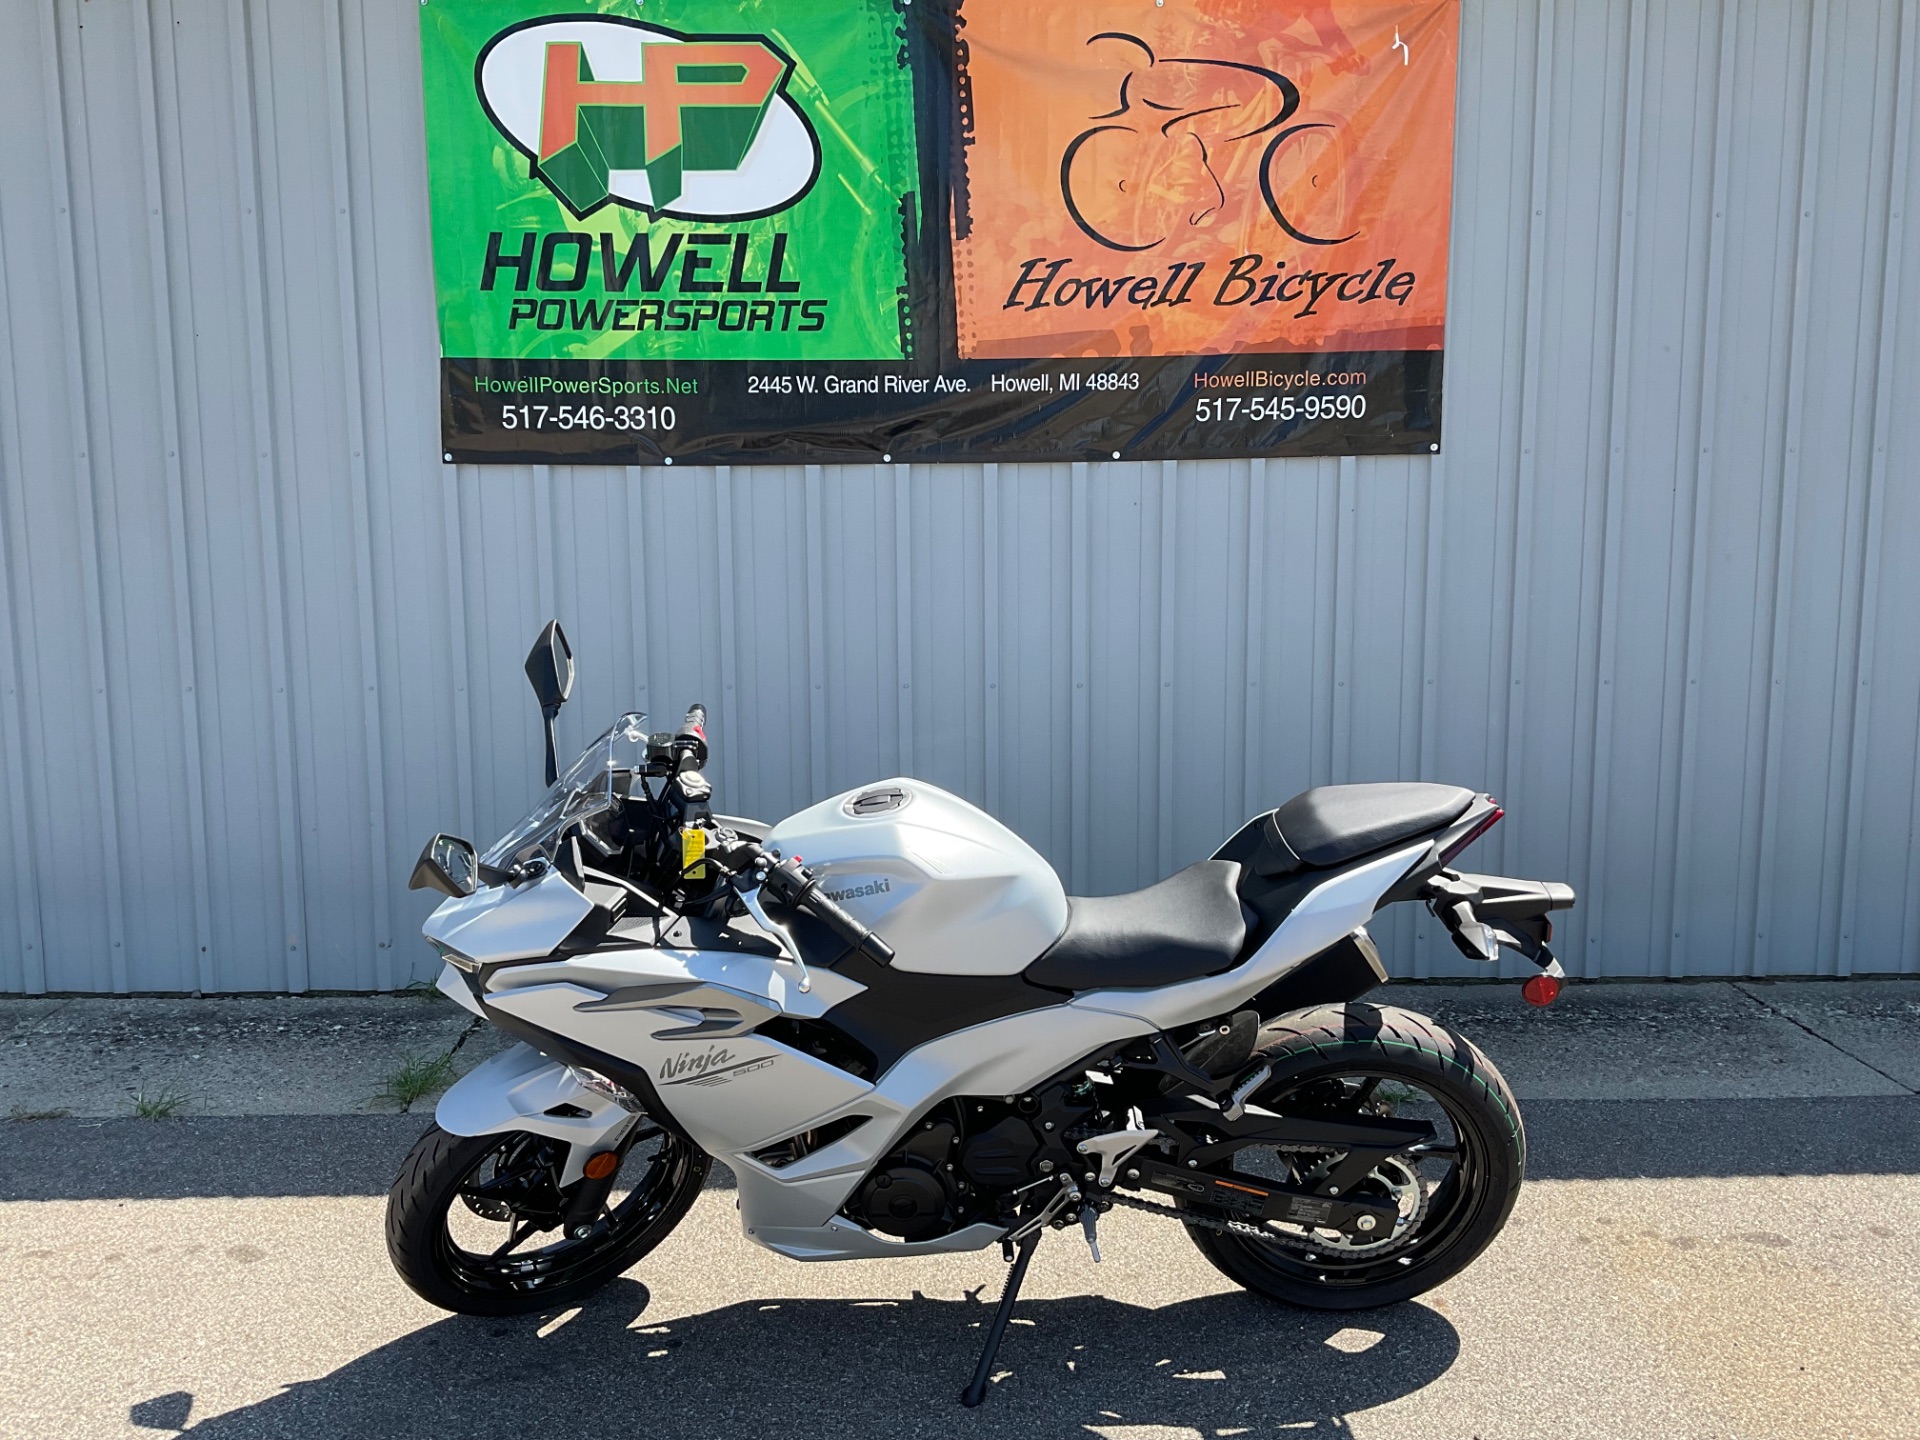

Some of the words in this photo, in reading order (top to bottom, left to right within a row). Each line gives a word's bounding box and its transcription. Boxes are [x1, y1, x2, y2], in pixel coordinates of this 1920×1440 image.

[537, 40, 788, 166] HP
[480, 231, 801, 293] HOWELL
[1003, 257, 1205, 312] Howell
[1212, 254, 1416, 318] Bicycle
[508, 298, 828, 332] POWERSPORTS
[474, 376, 698, 397] HowellPowerSports.Net
[748, 376, 792, 394] 2445
[796, 375, 819, 394] W.
[824, 374, 879, 394] Grand
[884, 375, 930, 393] River
[933, 374, 971, 393] Ave.
[991, 373, 1054, 394] Howell,
[1059, 373, 1080, 392] MI
[1085, 372, 1140, 391] 48843
[1193, 370, 1367, 391] HowellBicycle.com
[502, 405, 676, 430] 517-546-3310
[1195, 394, 1367, 422] 517-545-9590
[659, 1044, 737, 1080] Ninja
[732, 1059, 775, 1077] 500
